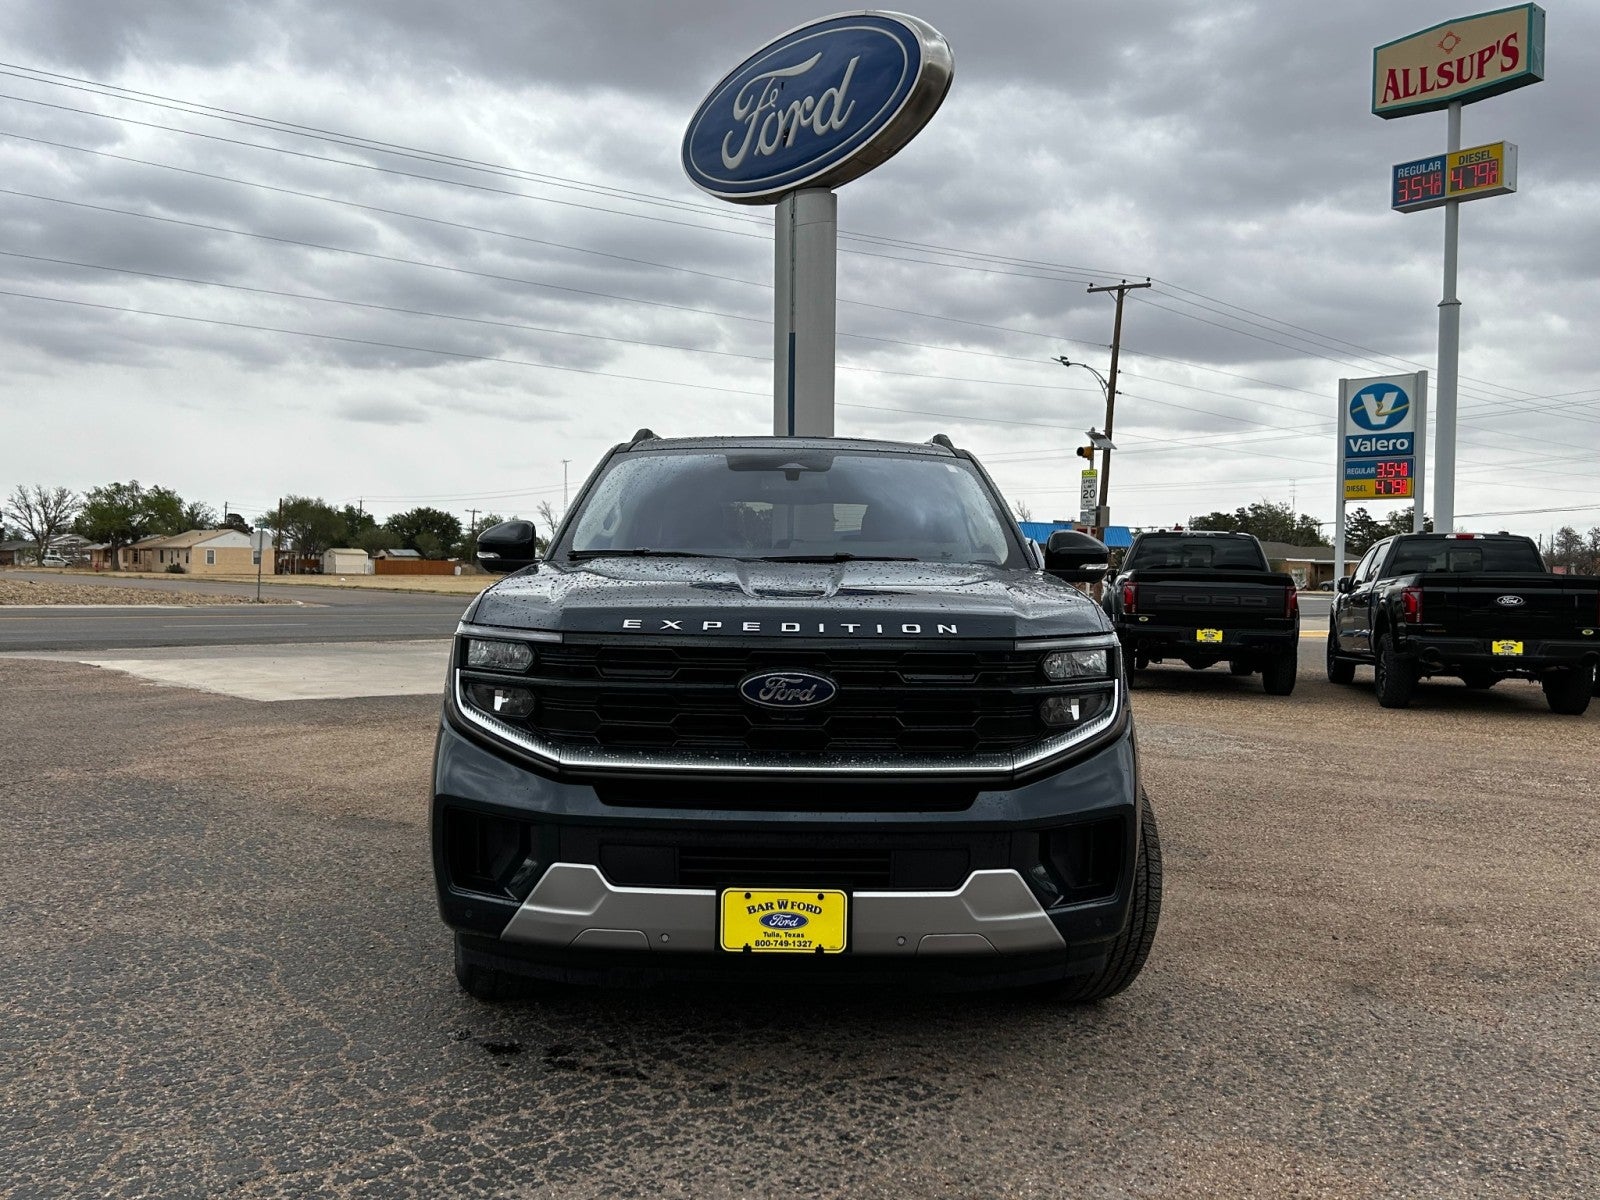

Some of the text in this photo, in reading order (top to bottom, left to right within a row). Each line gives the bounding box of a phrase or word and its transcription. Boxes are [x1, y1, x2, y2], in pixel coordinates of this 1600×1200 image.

[1381, 32, 1520, 104] ALLSUP'S
[721, 52, 861, 169] Ford
[1459, 150, 1493, 165] DIESEL
[1397, 160, 1441, 178] REGULAR
[1349, 437, 1409, 452] Valero
[1346, 466, 1376, 475] REGULAR
[1082, 489, 1096, 499] 20
[1346, 484, 1367, 492] DIESEL
[623, 619, 958, 634] EXPEDITION
[759, 676, 818, 701] Ford
[747, 899, 822, 915] BAR W FORD
[769, 913, 799, 927] Ford
[755, 940, 813, 948] 800-749-1327
